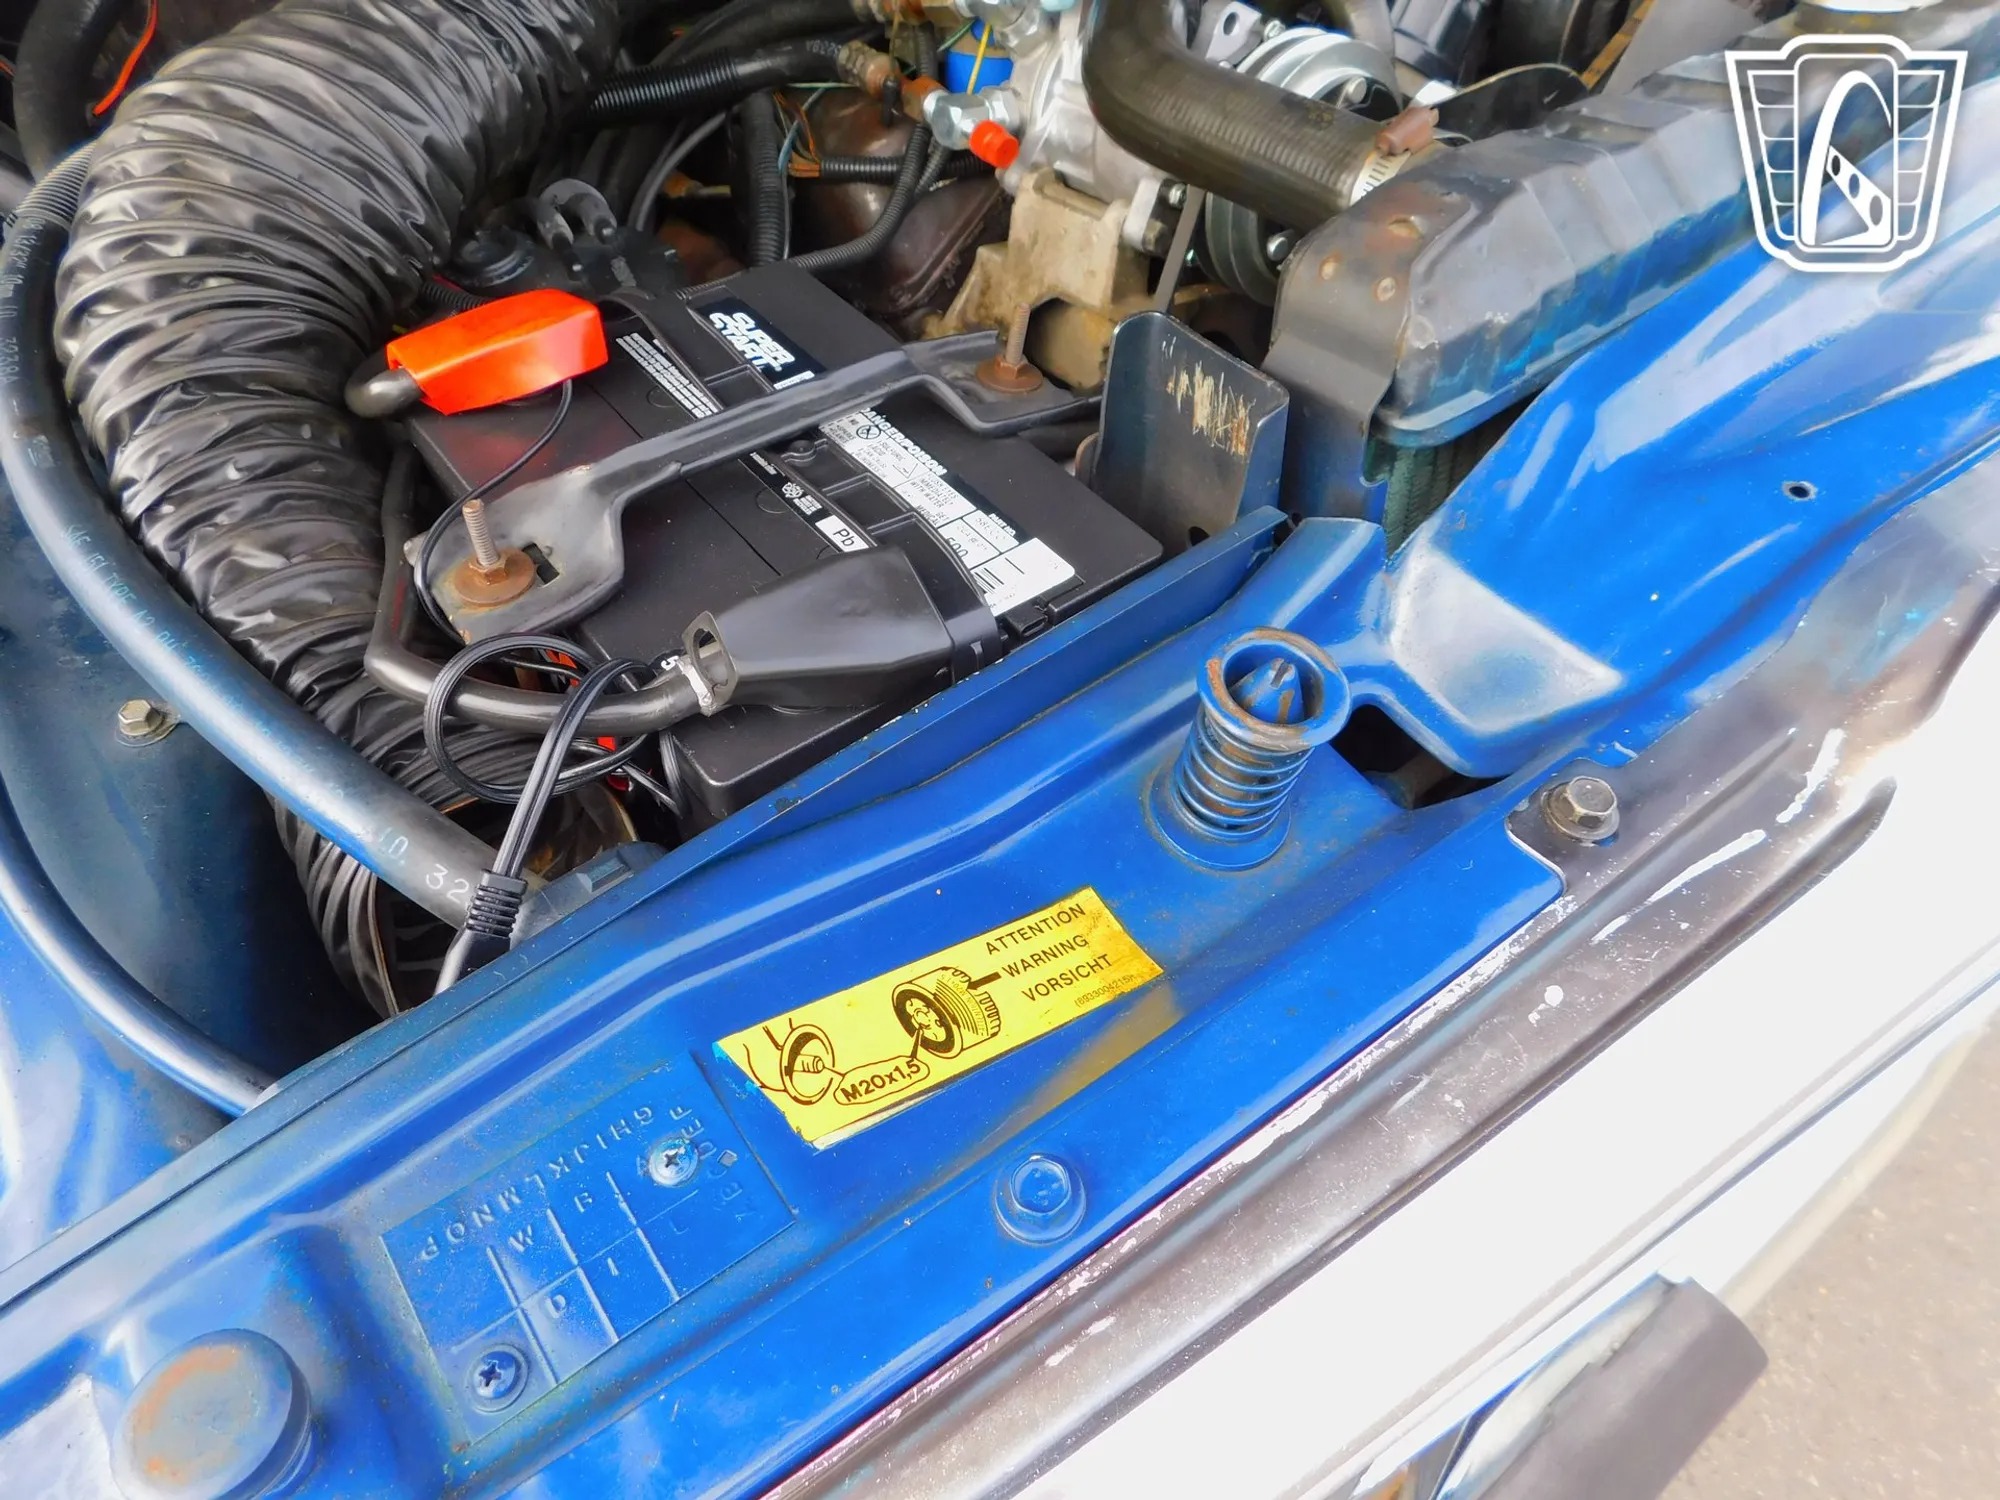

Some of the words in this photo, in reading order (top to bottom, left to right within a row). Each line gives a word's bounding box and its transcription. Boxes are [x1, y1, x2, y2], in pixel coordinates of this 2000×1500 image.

[709, 312, 778, 370] START
[732, 312, 795, 364] SUPER
[833, 528, 855, 547] Pb
[985, 903, 1086, 955] ATTENTION
[1002, 934, 1090, 978] WARNING
[1022, 953, 1113, 1003] VORSICHT
[840, 1059, 922, 1103] M20x1,5
